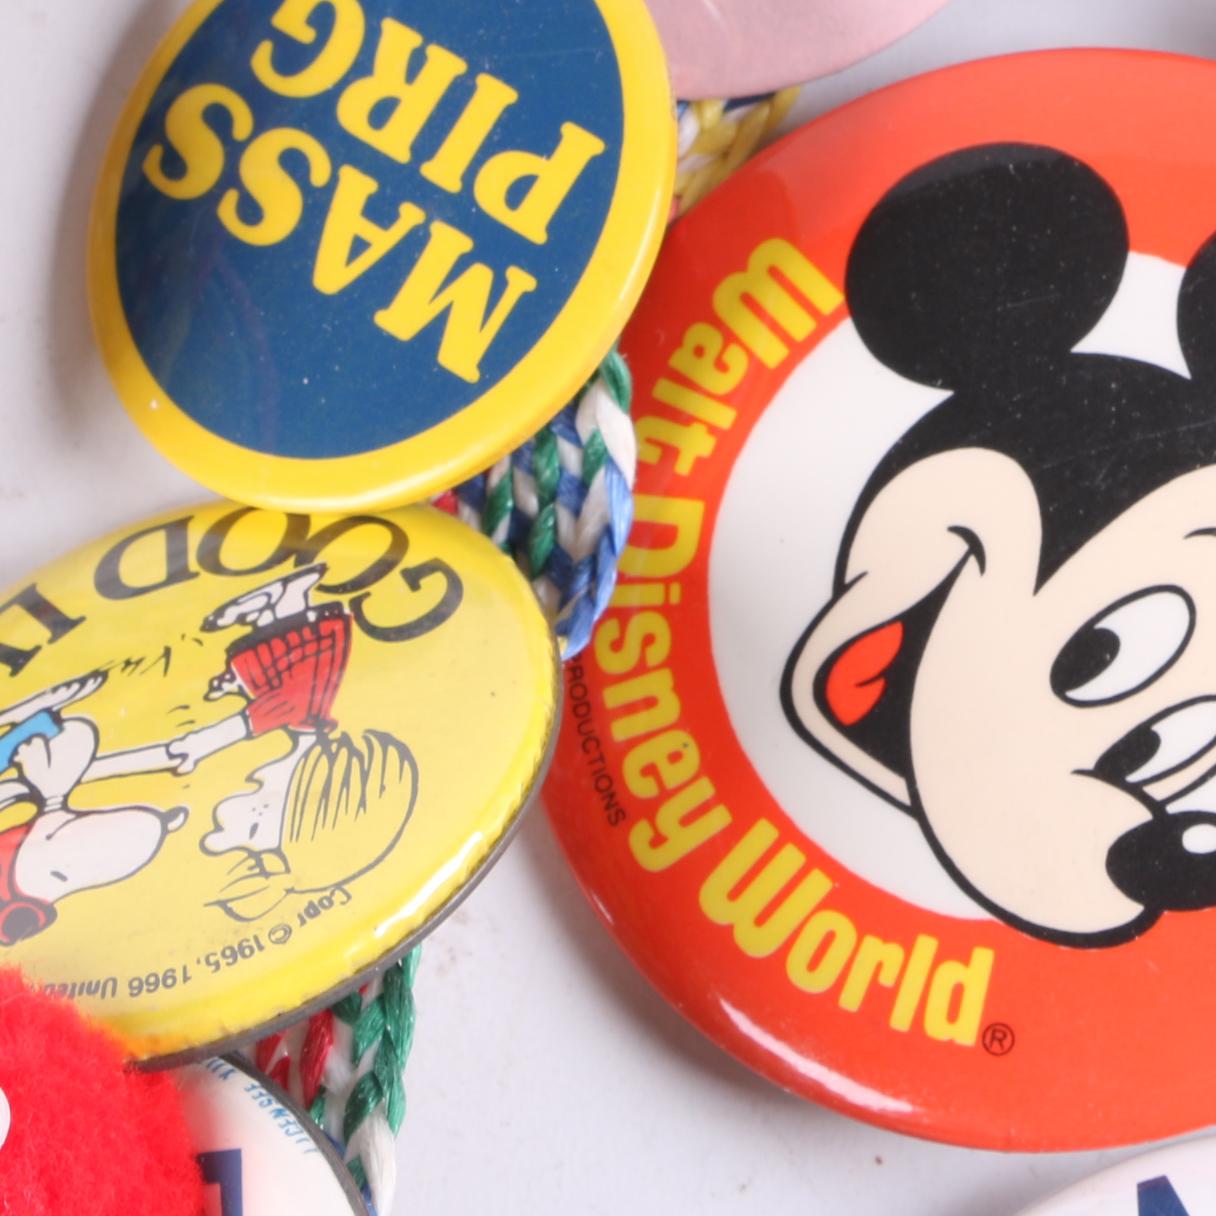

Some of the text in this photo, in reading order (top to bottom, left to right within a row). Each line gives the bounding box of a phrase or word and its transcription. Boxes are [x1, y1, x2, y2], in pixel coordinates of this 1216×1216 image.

[142, 83, 537, 384] MASS
[635, 237, 845, 478] Walt
[92, 506, 464, 643] GOOD
[567, 652, 627, 828] RODUCTIONS
[594, 496, 732, 873] Disney
[128, 964, 192, 997] 1966
